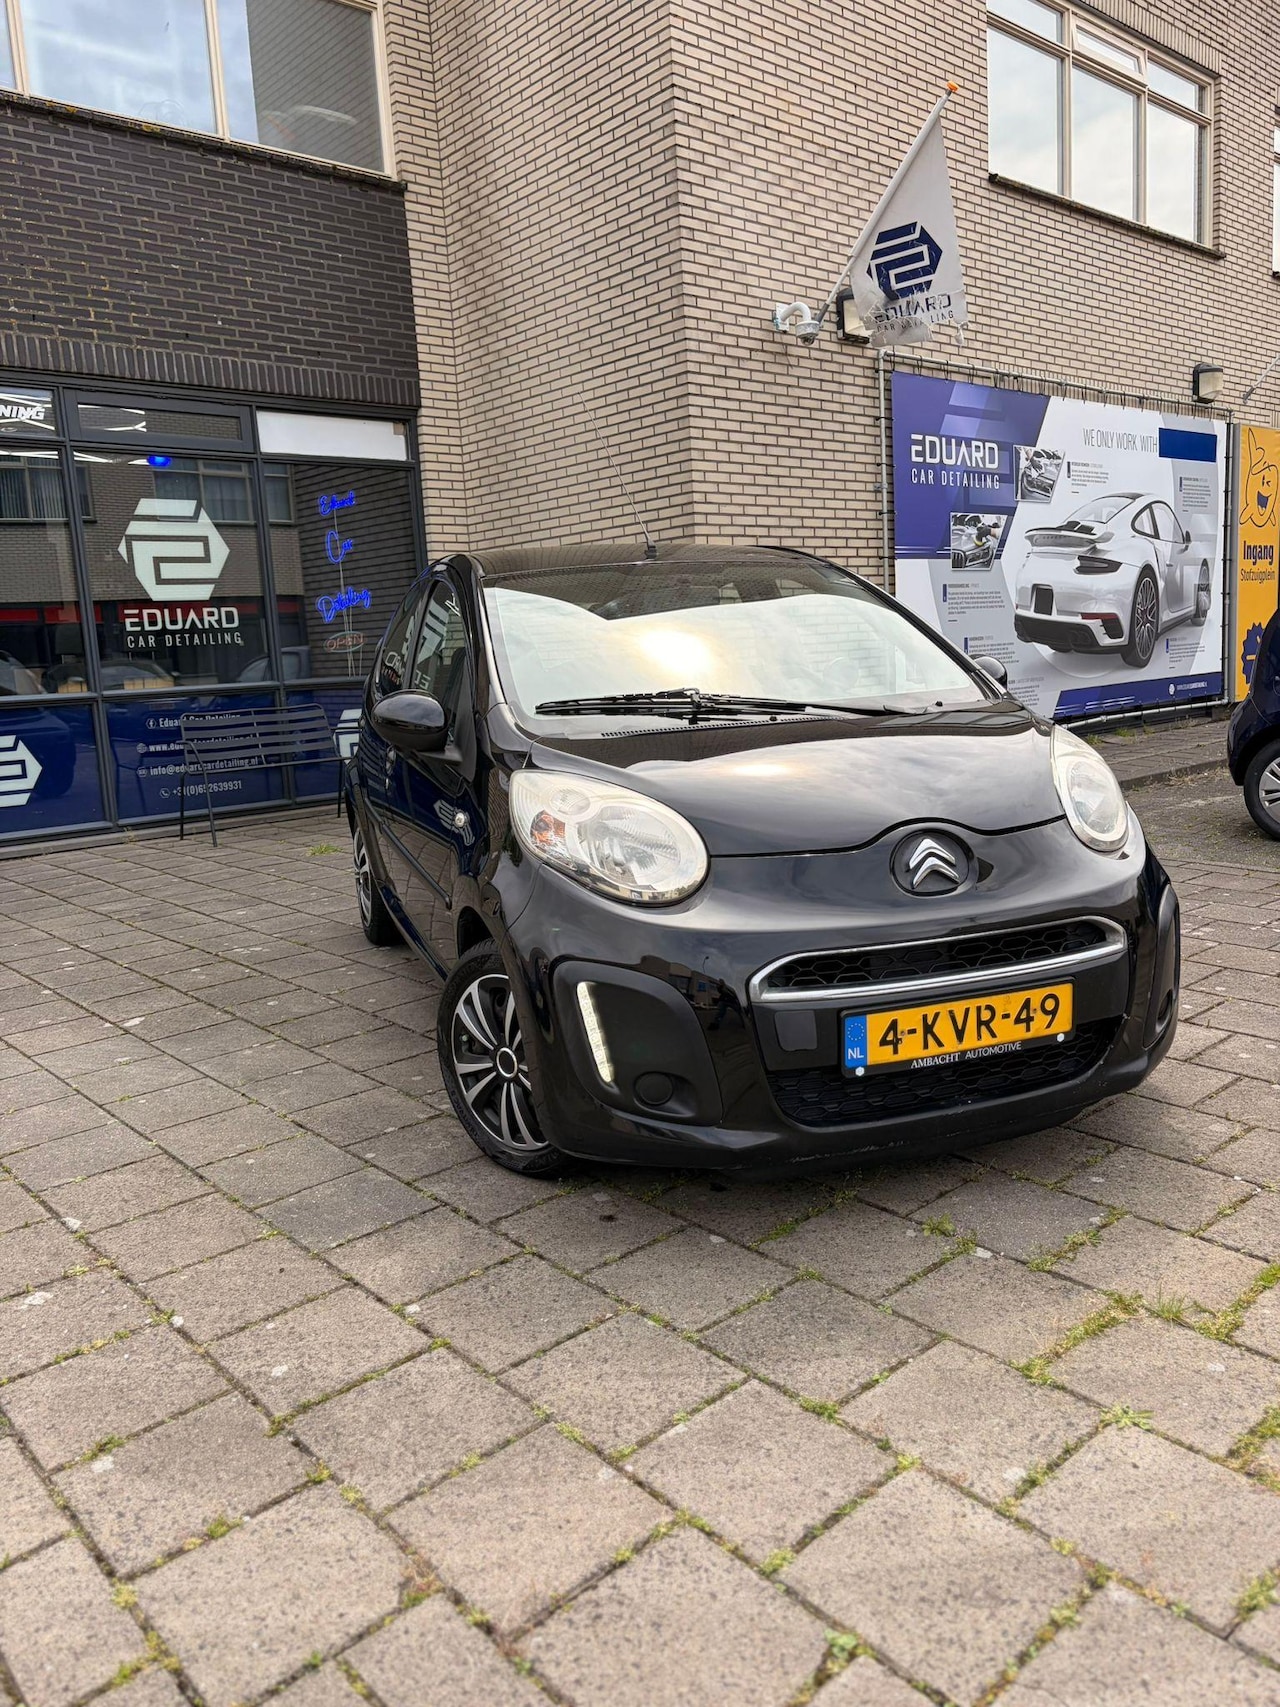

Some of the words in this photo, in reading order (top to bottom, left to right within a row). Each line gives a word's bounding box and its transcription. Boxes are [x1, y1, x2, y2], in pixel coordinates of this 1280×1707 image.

[911, 433, 999, 469] EDUARD
[1083, 428, 1095, 447] WE
[1096, 429, 1115, 449] ONLY
[1115, 432, 1137, 451] WORK
[1140, 434, 1157, 453] WITH
[911, 468, 934, 485] CAR
[941, 470, 1000, 489] DETAILING
[326, 529, 353, 563] Car
[1243, 540, 1274, 565] Ingang
[1240, 567, 1276, 584] Stofzuigplein
[317, 587, 371, 623] Detailing
[124, 606, 239, 632] EDUARD
[127, 635, 156, 648] CAR
[165, 632, 242, 647] DETAILING
[326, 633, 363, 651] OPEN
[879, 993, 1060, 1055] 4-KVR-49
[848, 1047, 864, 1060] NL
[910, 1051, 960, 1069] AMBACHT
[965, 1041, 1021, 1060] AUTOMOTIVE
